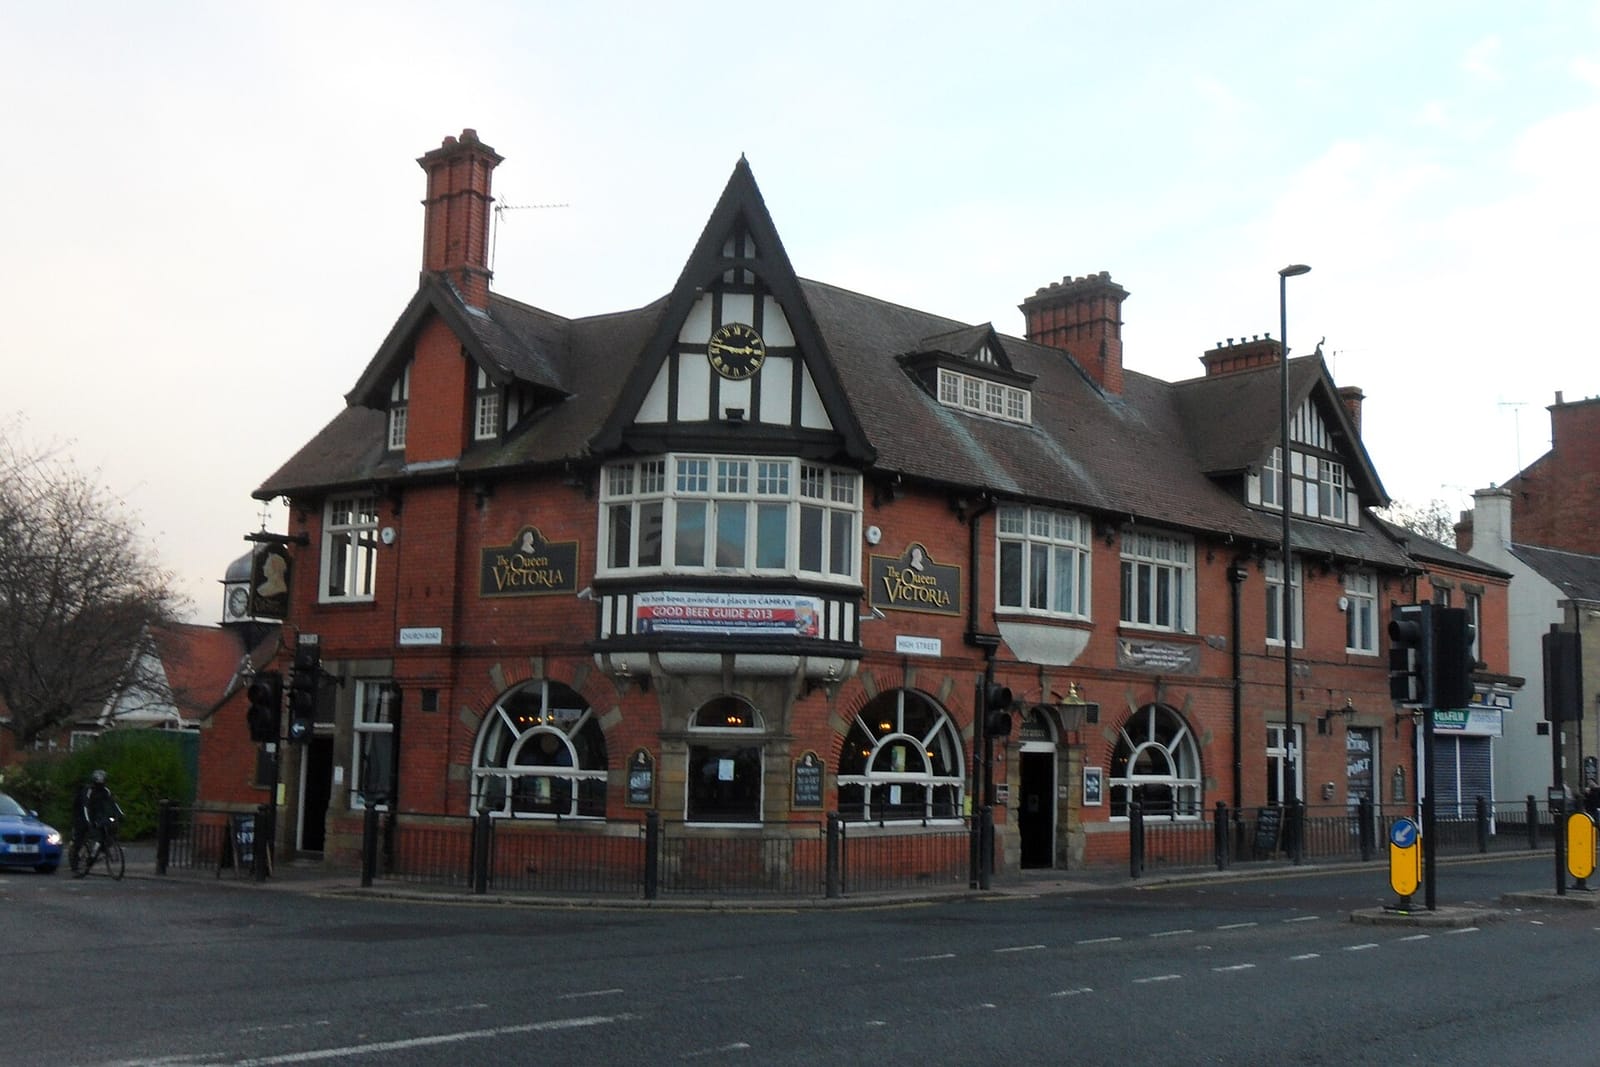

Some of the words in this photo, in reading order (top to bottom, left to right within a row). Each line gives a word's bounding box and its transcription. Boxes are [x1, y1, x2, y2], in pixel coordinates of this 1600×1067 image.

[496, 554, 509, 566] The
[510, 553, 549, 573] Queen
[492, 566, 564, 592] VICTORIA
[887, 566, 900, 578] The
[901, 568, 937, 587] Queen
[882, 576, 951, 607] VICTORIA
[652, 606, 684, 617] GOOD
[685, 607, 710, 618] BEER
[712, 607, 745, 619] GUIDE
[747, 608, 773, 620] 2013
[915, 640, 938, 652] STREET
